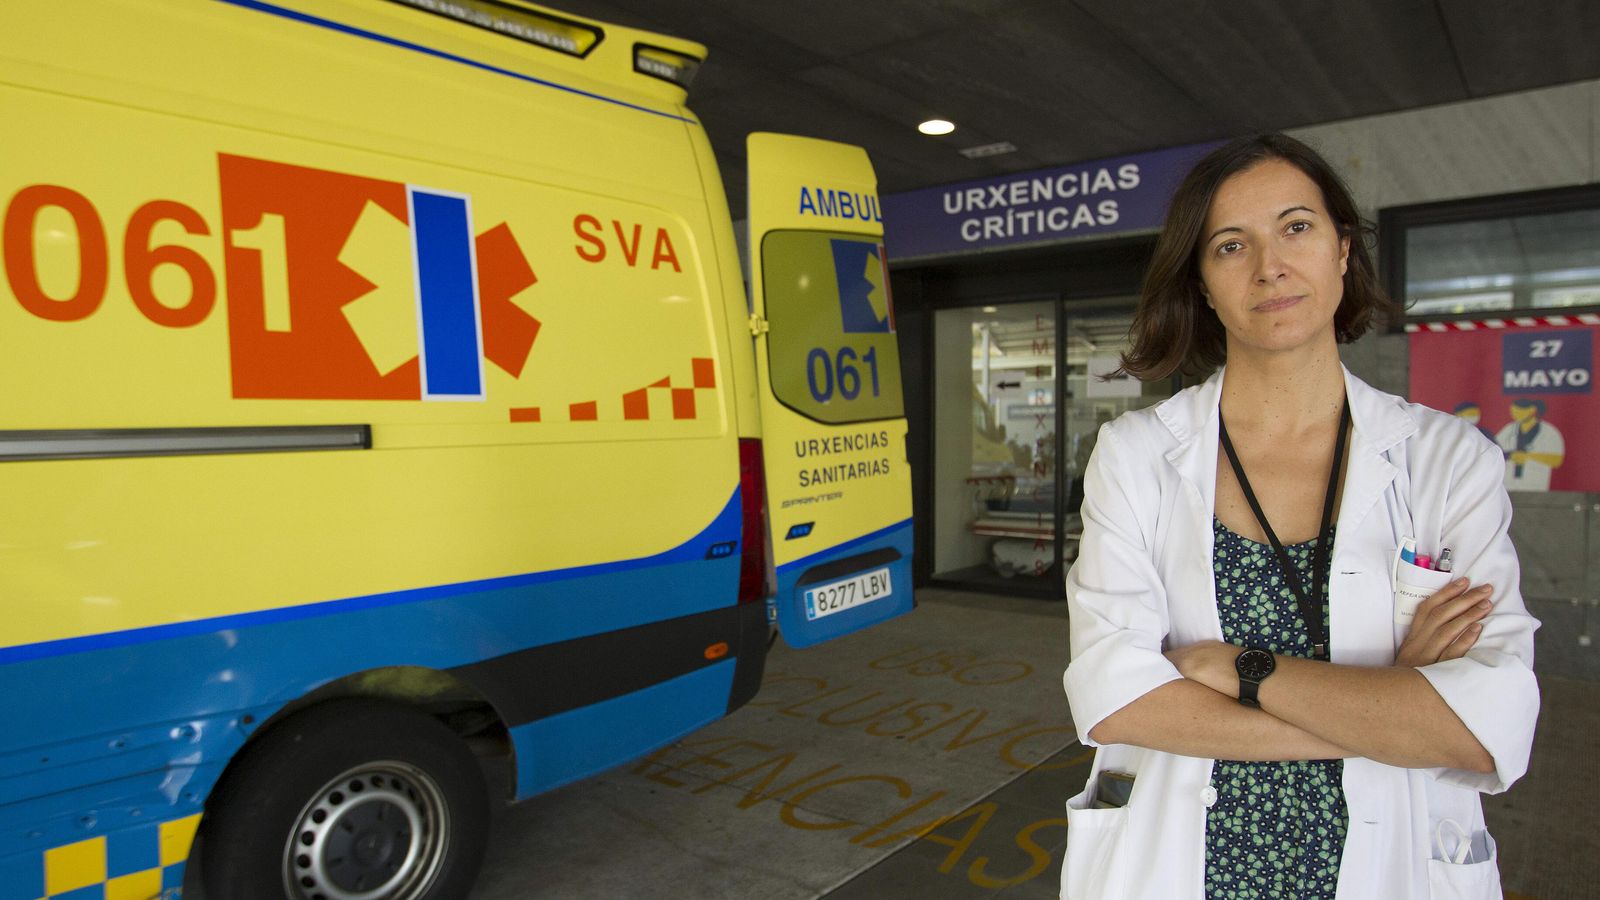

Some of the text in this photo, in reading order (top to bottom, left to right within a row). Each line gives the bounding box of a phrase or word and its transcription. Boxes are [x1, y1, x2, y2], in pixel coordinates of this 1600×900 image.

[799, 186, 882, 222] AMBUL
[943, 163, 1140, 215] URXENCIAS
[960, 199, 1120, 242] CRÍTICAS
[3, 183, 292, 330] 061
[573, 213, 682, 273] SVA
[1529, 339, 1563, 358] 27
[807, 345, 880, 404] 061
[1503, 368, 1590, 388] MAYO
[795, 430, 889, 458] URXENCIAS
[799, 458, 890, 487] SANITARIAS
[781, 491, 844, 509] SPRINTER
[817, 571, 887, 612] 8277 LBV
[868, 646, 1034, 686] USO
[745, 671, 1093, 770] CLUSIVO
